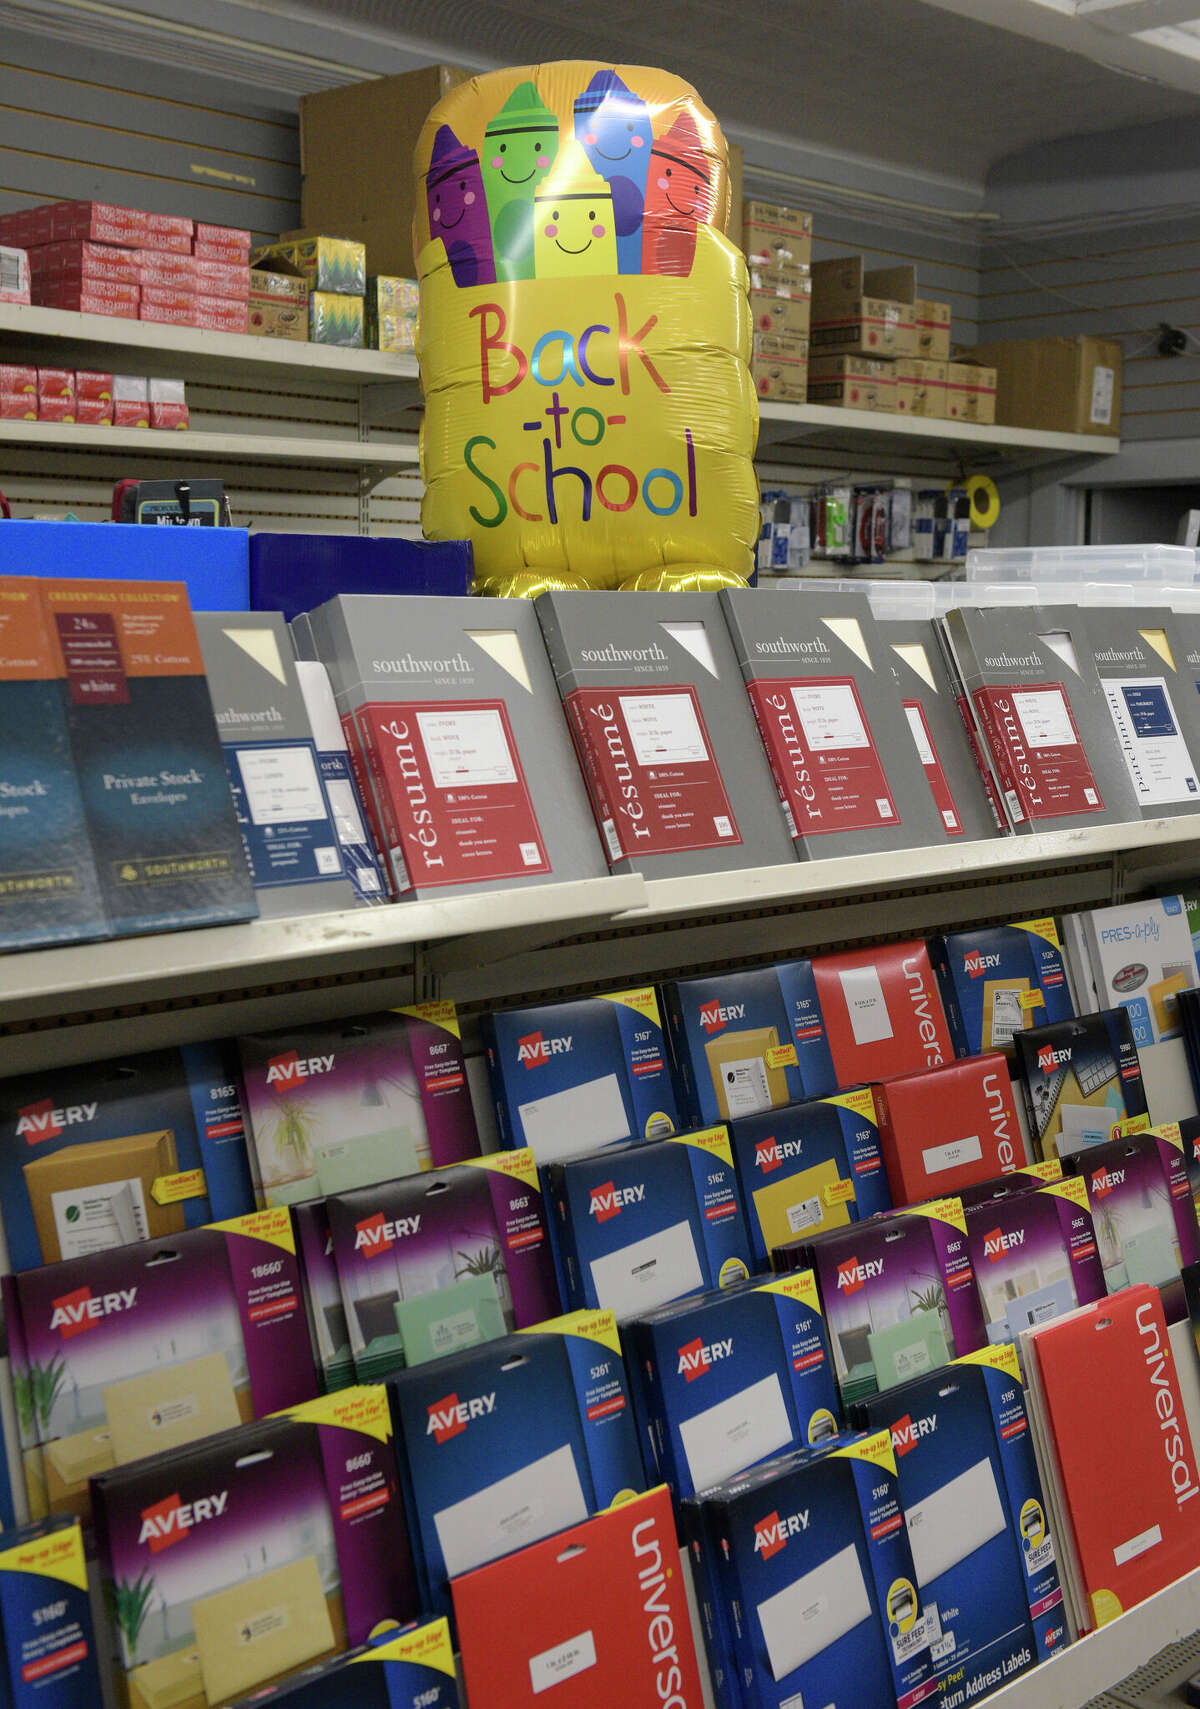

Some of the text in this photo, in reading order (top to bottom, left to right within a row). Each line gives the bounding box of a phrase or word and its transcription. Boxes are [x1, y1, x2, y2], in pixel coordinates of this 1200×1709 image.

[469, 293, 671, 404] Back
[464, 428, 697, 528] School
[581, 643, 664, 662] southworth
[755, 637, 828, 654] southworth
[984, 651, 1042, 668] southworth
[372, 653, 470, 673] southworth
[216, 706, 282, 724] uthworth
[766, 694, 823, 820] résumé
[994, 699, 1044, 807] résumé
[103, 768, 203, 790] Private Stock
[589, 703, 651, 839] résumé
[380, 719, 445, 868] résumé
[145, 858, 228, 877] SOUTHWORTH
[963, 953, 1000, 973] AVERY
[699, 1003, 745, 1027] AVERY
[902, 957, 944, 1067] univers
[517, 1035, 573, 1062] AVERY
[634, 1031, 650, 1042] 5167
[265, 1054, 335, 1085] AVERY
[1038, 1048, 1072, 1068] AVERY
[210, 1085, 236, 1100] 8165
[15, 1102, 98, 1136] AVERY
[983, 1074, 1017, 1173] univer
[855, 1130, 870, 1142] 5163
[755, 1139, 802, 1167] AVERY
[707, 1173, 724, 1186] 5162
[1091, 1169, 1126, 1193] AVERY
[588, 1183, 645, 1215] AVERY
[354, 1214, 421, 1250] AVERY
[983, 1229, 1025, 1257] AVERY
[837, 1258, 884, 1289] AVERY
[50, 1287, 137, 1330] AVERY
[795, 1320, 811, 1335] 5161
[677, 1337, 733, 1375] AVERY
[590, 1363, 609, 1380] 5261
[426, 1391, 496, 1436] AVERY
[1135, 1302, 1200, 1504] universal
[891, 1413, 938, 1449] AVERY
[872, 1484, 888, 1500] 5160
[137, 1490, 228, 1544] AVERY
[753, 1509, 810, 1553] AVERY
[632, 1517, 688, 1709] univers
[941, 1607, 960, 1622] White
[965, 1667, 1001, 1700] Address
[1002, 1647, 1031, 1677] Labels
